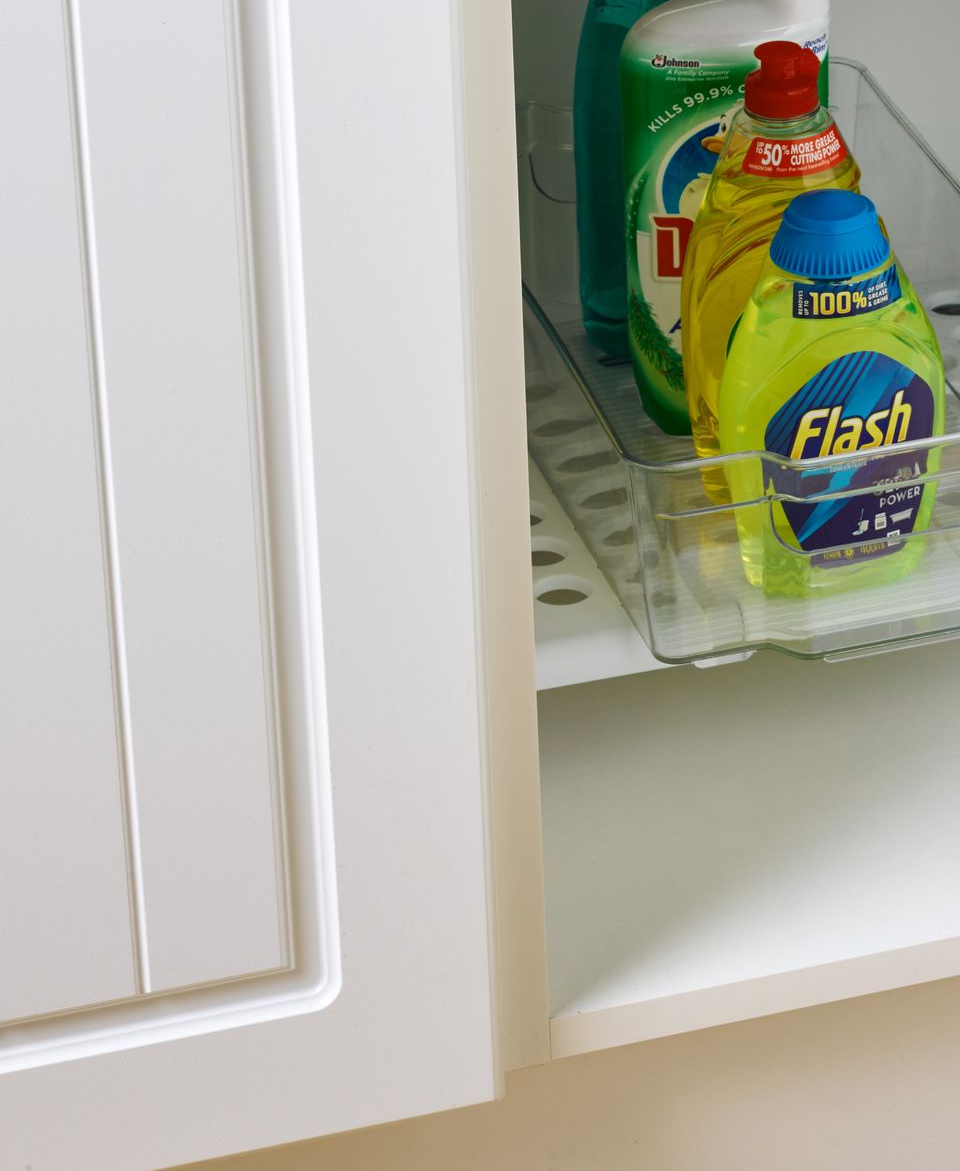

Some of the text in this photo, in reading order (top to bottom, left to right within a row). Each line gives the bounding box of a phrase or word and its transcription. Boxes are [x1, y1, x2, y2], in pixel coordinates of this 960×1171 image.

[651, 55, 700, 68] Johnson
[673, 69, 697, 77] Family
[698, 69, 730, 77] Company
[648, 85, 734, 133] KILLS 99.9%
[790, 130, 836, 155] MORE GREASE
[790, 139, 841, 166] CUTTING POWER
[868, 286, 875, 294] OF
[868, 288, 888, 301] GREASE
[873, 295, 889, 307] GRIME
[809, 290, 867, 316] 100%
[790, 390, 912, 460] Flash
[879, 486, 921, 509] POWER
